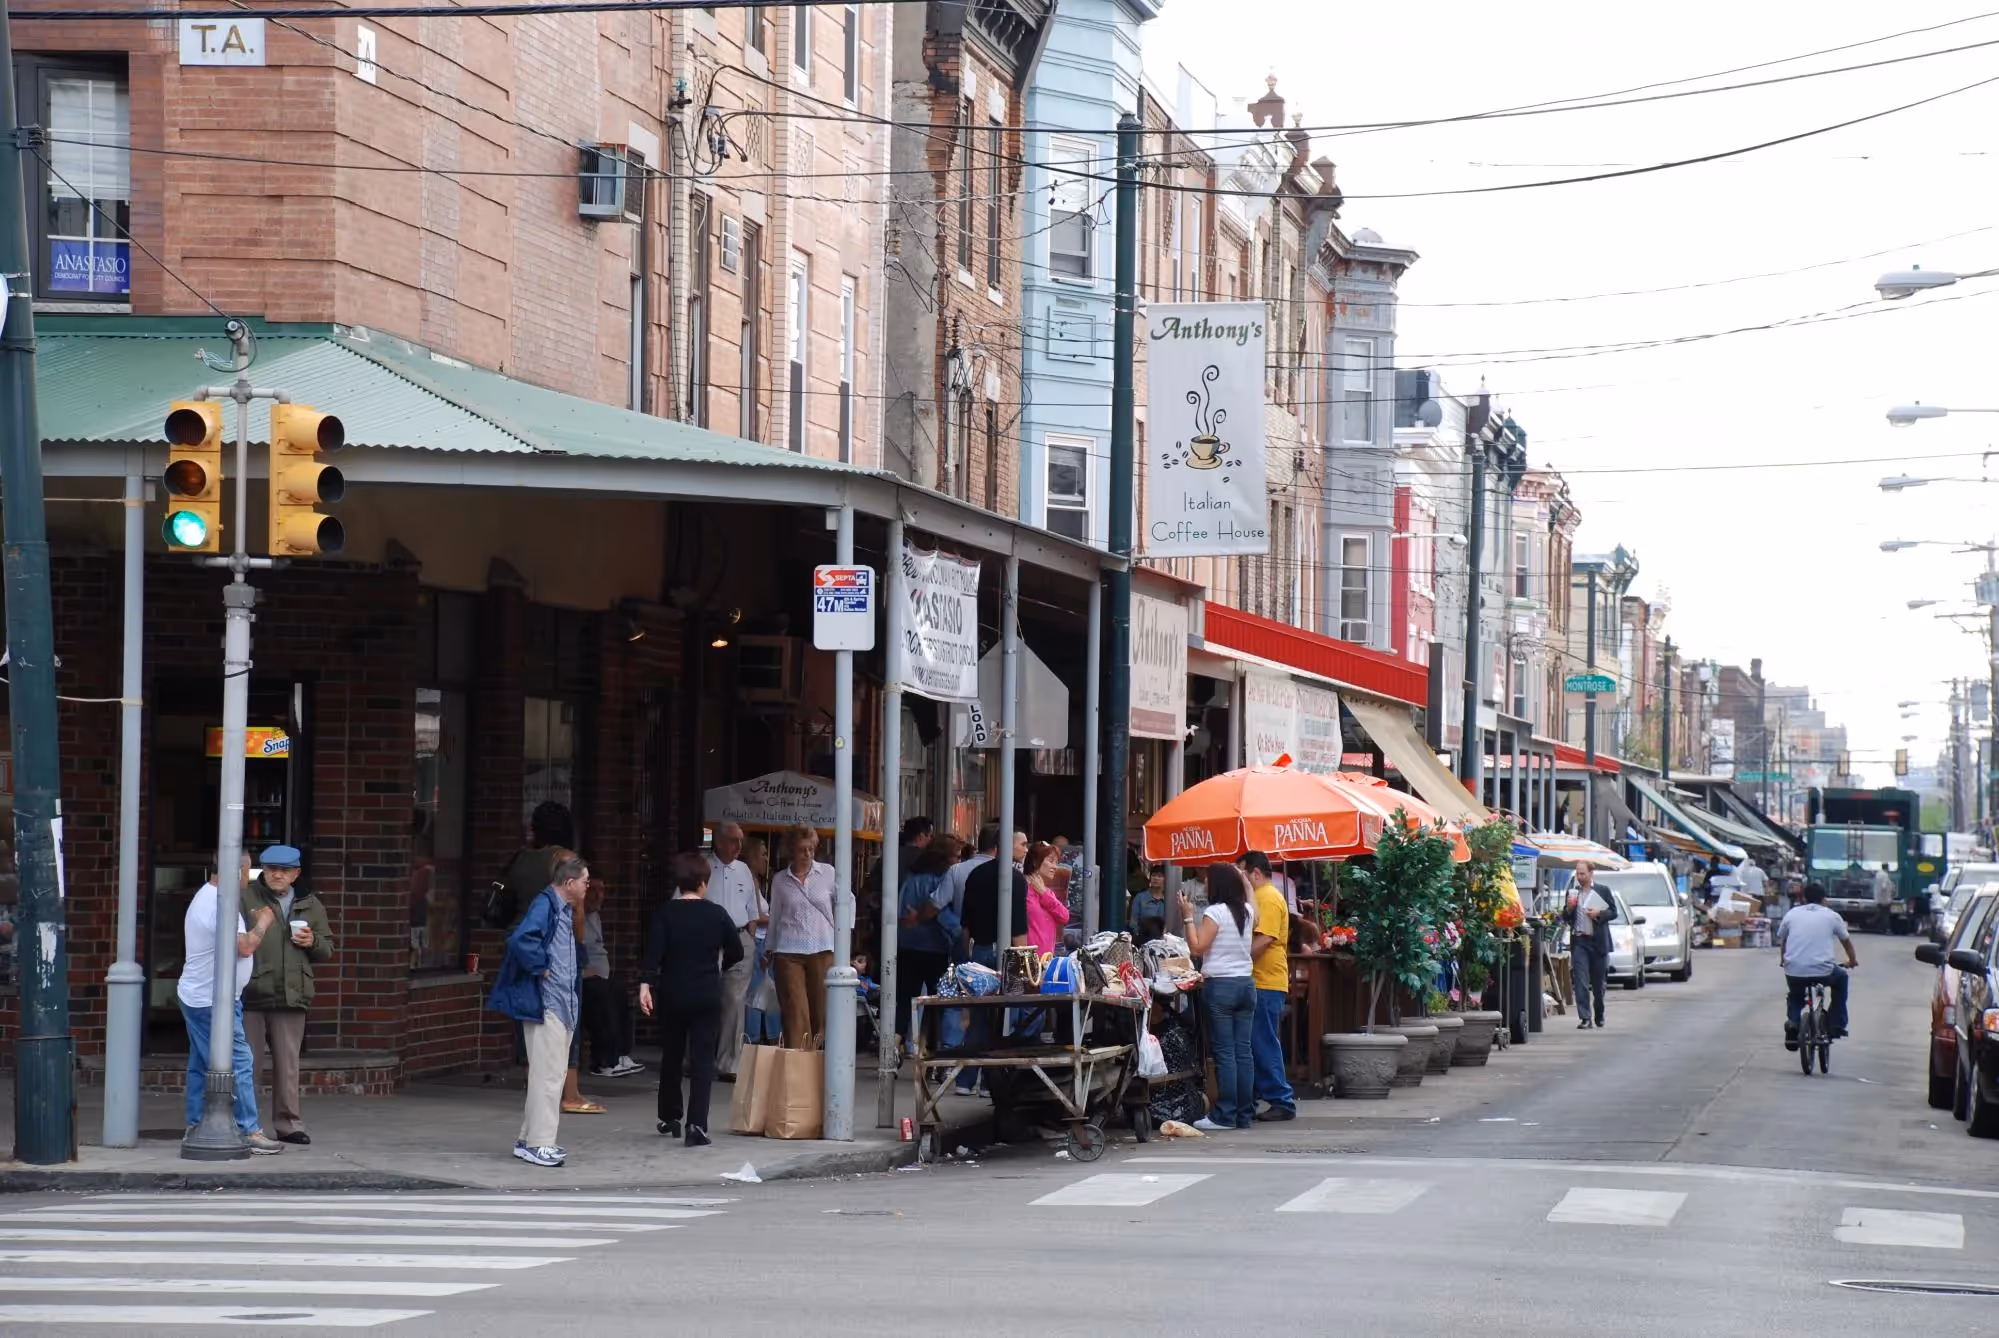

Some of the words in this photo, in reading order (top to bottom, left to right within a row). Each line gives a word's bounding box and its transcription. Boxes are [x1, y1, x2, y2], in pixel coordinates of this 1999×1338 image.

[191, 24, 255, 54] T.A.
[55, 254, 126, 273] ANASTASIO
[1150, 317, 1262, 346] Anthony's
[1183, 490, 1231, 512] Italian
[1151, 521, 1208, 542] Coffee
[1217, 520, 1265, 540] House
[1566, 680, 1606, 692] MONTROSE
[970, 705, 986, 742] LOAD
[750, 780, 818, 799] Anthony's
[766, 797, 795, 808] Coffee
[763, 809, 792, 821] Italian
[795, 812, 808, 823] Ice
[1171, 830, 1216, 857] PANNA
[1274, 821, 1329, 849] PANNA
